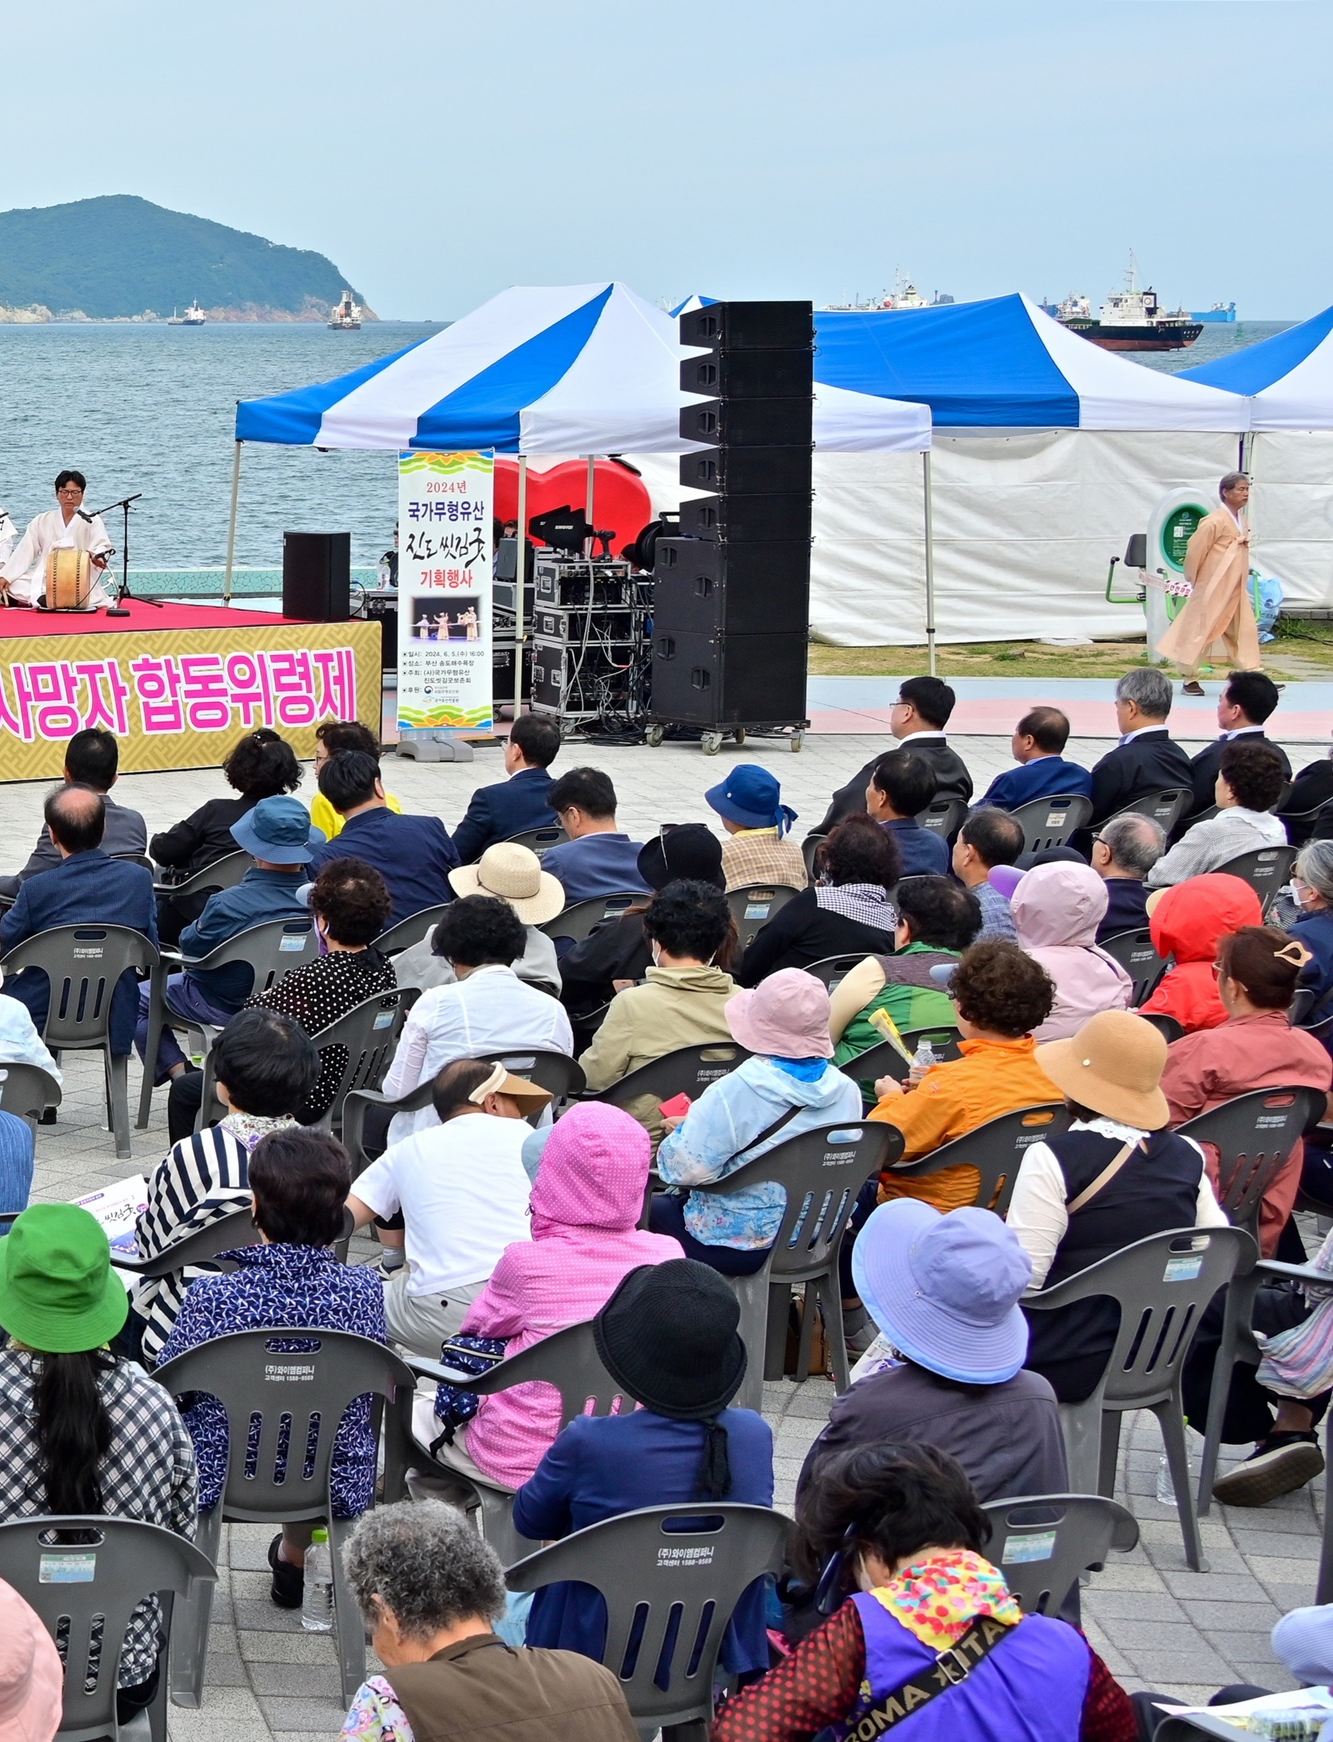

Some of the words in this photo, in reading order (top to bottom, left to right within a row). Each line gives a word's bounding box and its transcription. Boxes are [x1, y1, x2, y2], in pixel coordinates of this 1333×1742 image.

[426, 480, 467, 494] 2024년
[408, 500, 485, 522] 국가무형유산
[420, 569, 473, 589] 기획행사
[133, 649, 356, 732] 합동위령제
